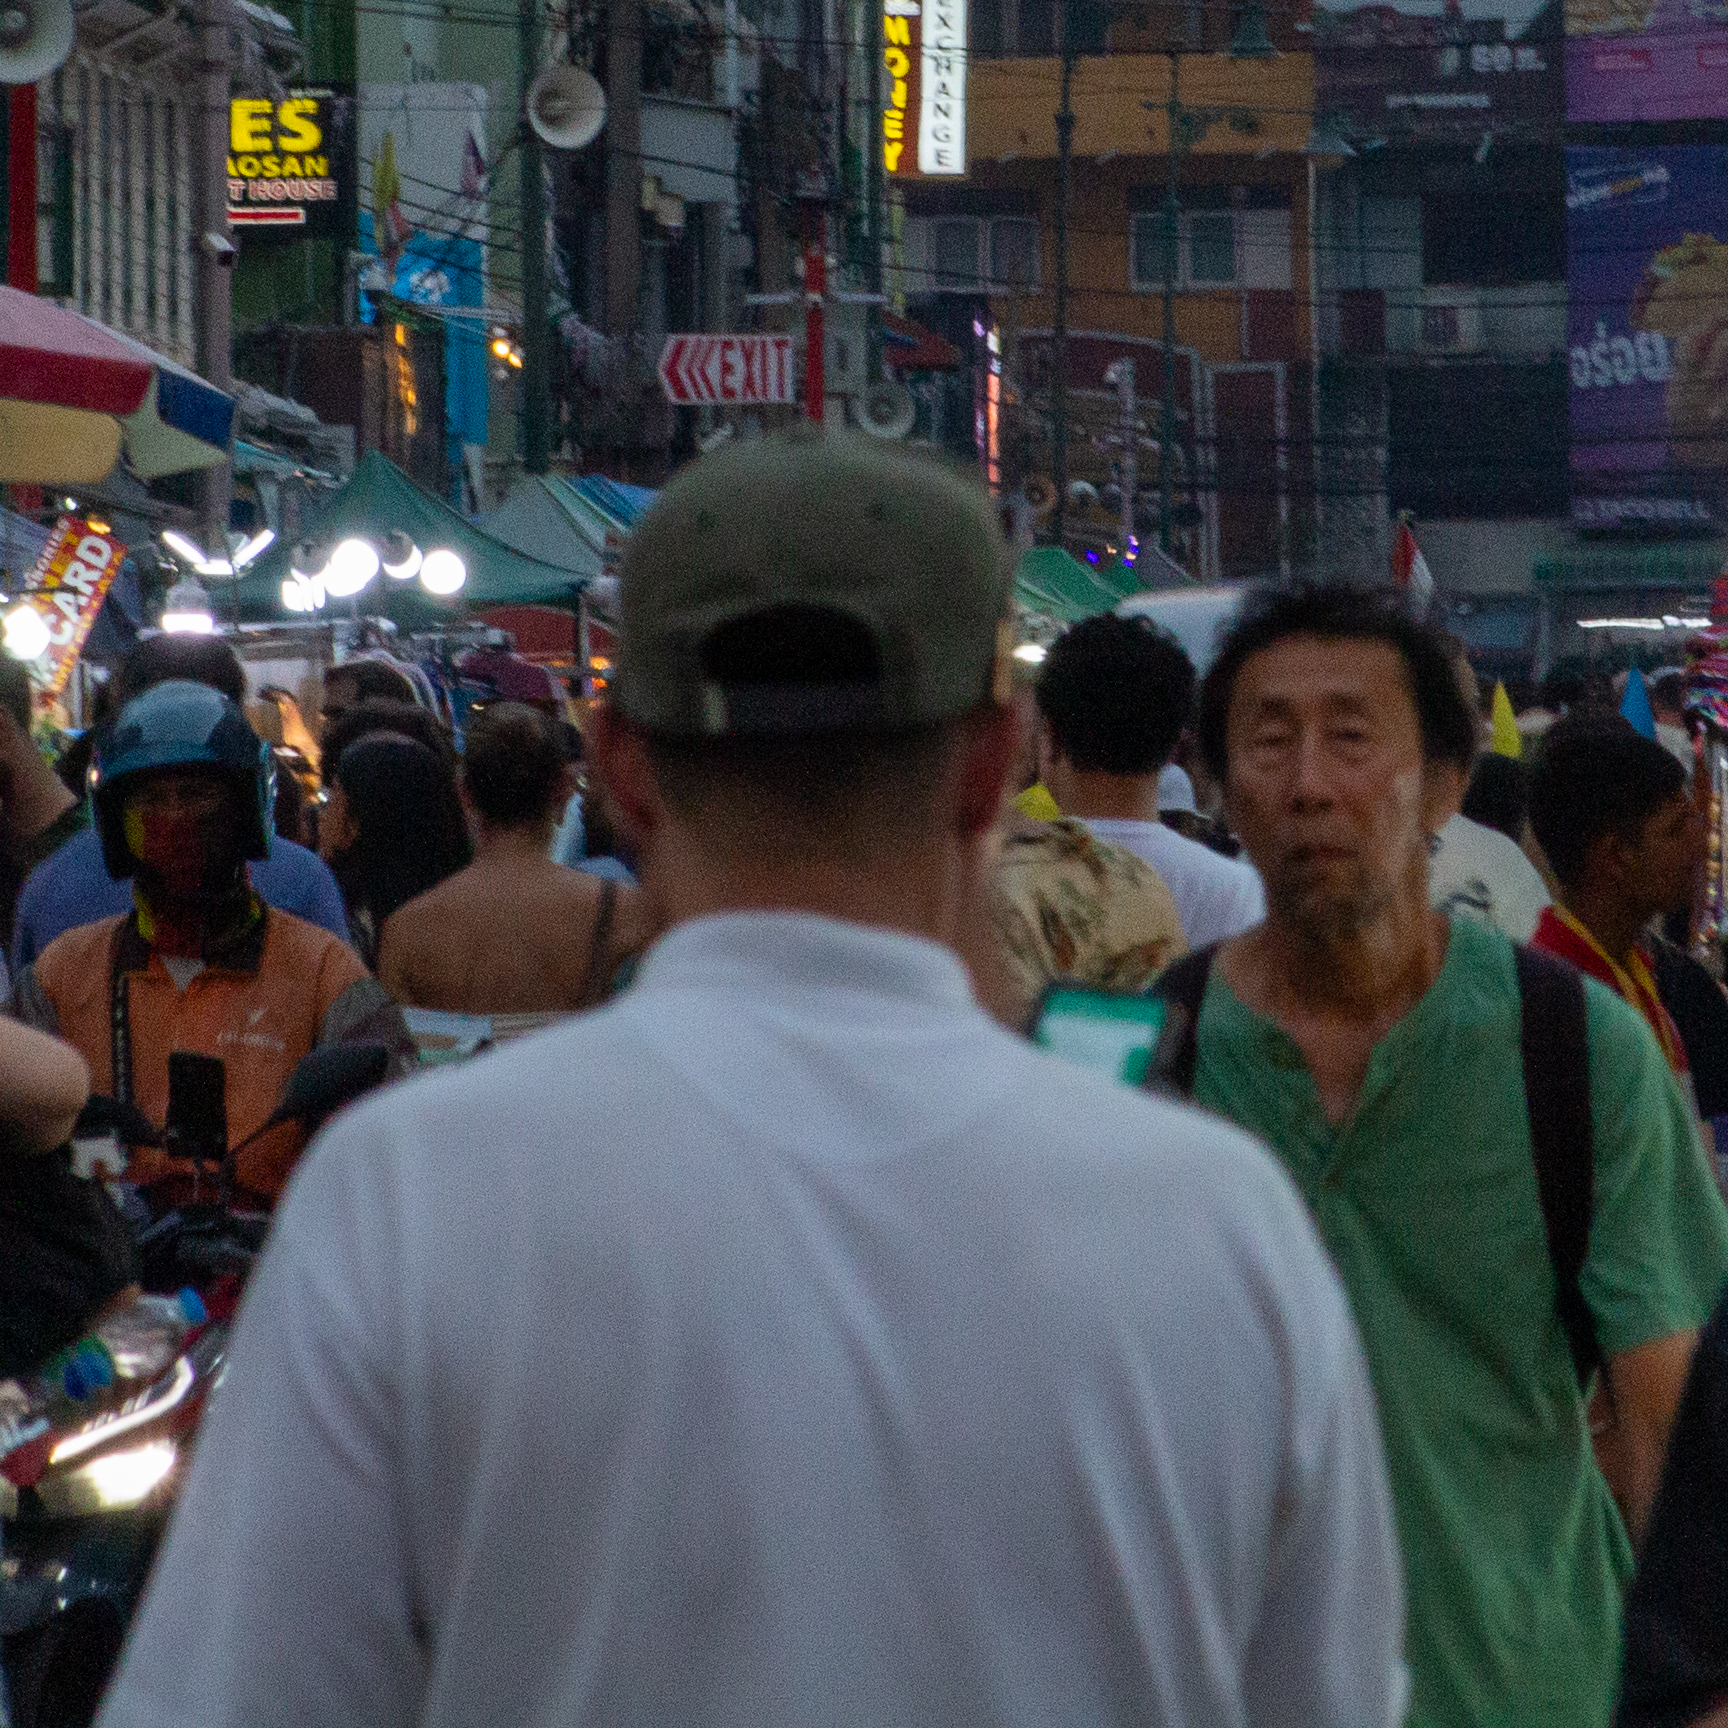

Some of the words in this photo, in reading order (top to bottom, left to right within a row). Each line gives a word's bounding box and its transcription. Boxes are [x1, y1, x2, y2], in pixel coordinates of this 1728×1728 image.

[248, 179, 337, 202] HOUSE
[719, 338, 789, 400] EXIT
[45, 535, 114, 646] CARD
